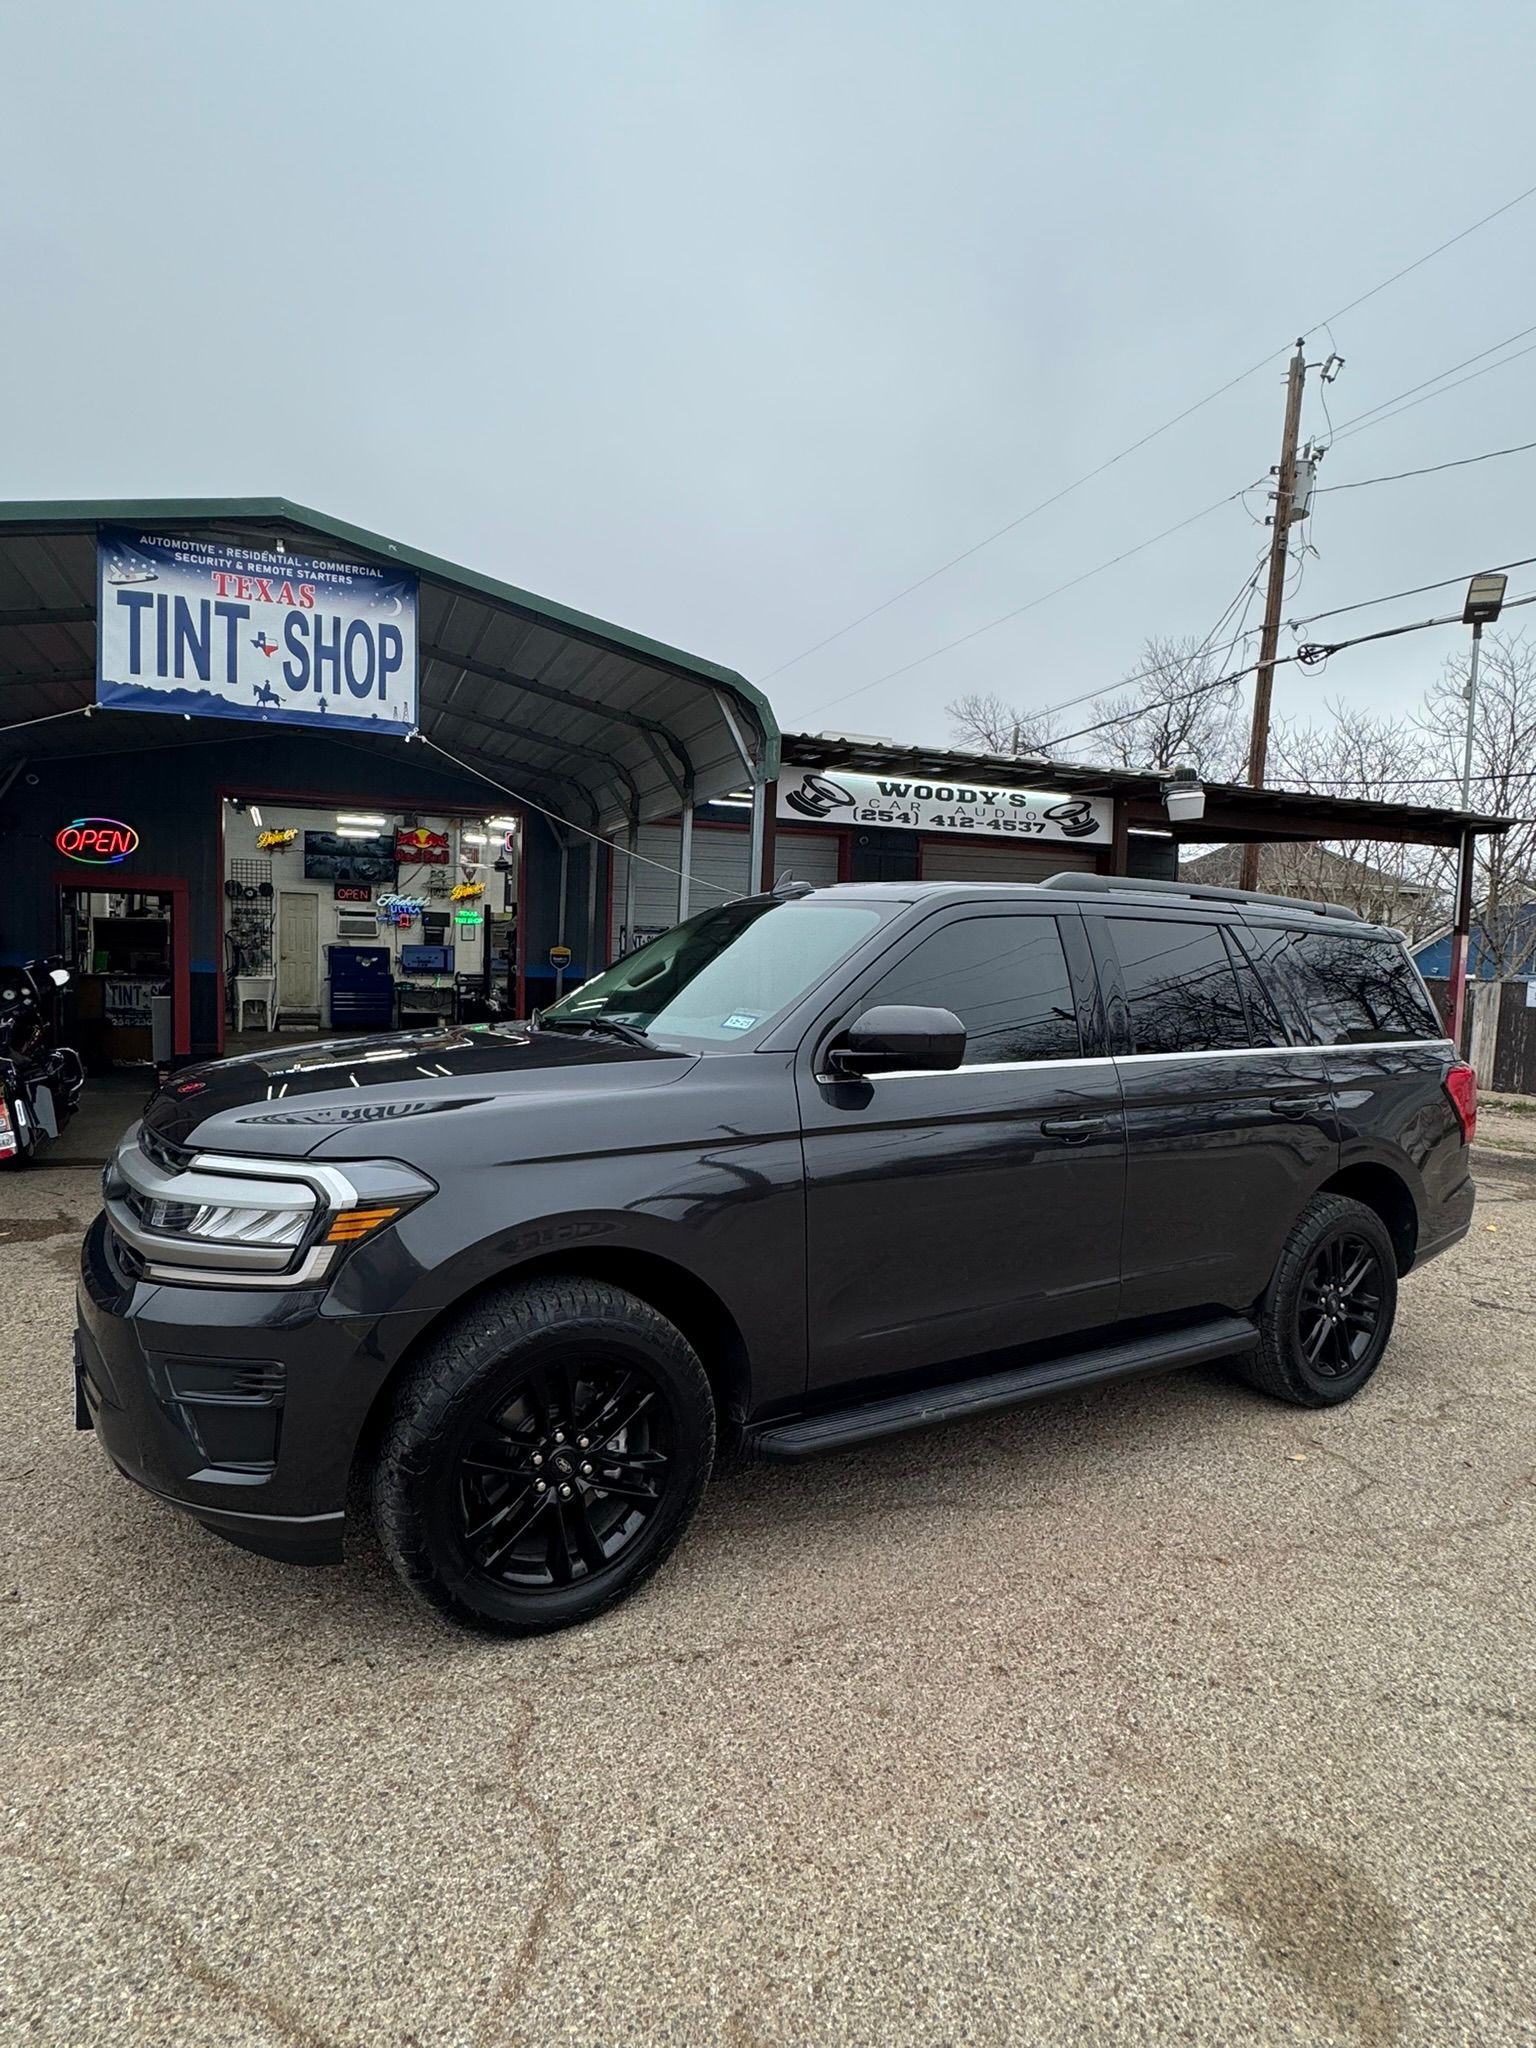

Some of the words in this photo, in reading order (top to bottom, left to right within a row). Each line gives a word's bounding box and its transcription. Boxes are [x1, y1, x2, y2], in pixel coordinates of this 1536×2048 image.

[139, 535, 215, 555] AUTOMOTIVE
[226, 547, 301, 567] RESIDENTIAL
[312, 560, 383, 578] COMMERCIAL
[174, 552, 232, 569] SECURITY
[236, 561, 243, 570] &
[247, 563, 293, 577] REMOTE
[297, 570, 352, 584] STARTERS
[211, 571, 316, 609] TEXAS
[117, 589, 250, 684] TINT
[282, 610, 403, 701] SHOP
[876, 782, 1027, 808] WOODY'S
[852, 809, 920, 826] (254)
[929, 815, 1047, 834] 412-4537
[868, 798, 921, 812] CAR
[954, 807, 1038, 821] AUDIO
[61, 829, 132, 852] OPEN
[337, 888, 369, 900] OPEN
[390, 905, 421, 914] ULTRA
[110, 985, 142, 1006] TINT
